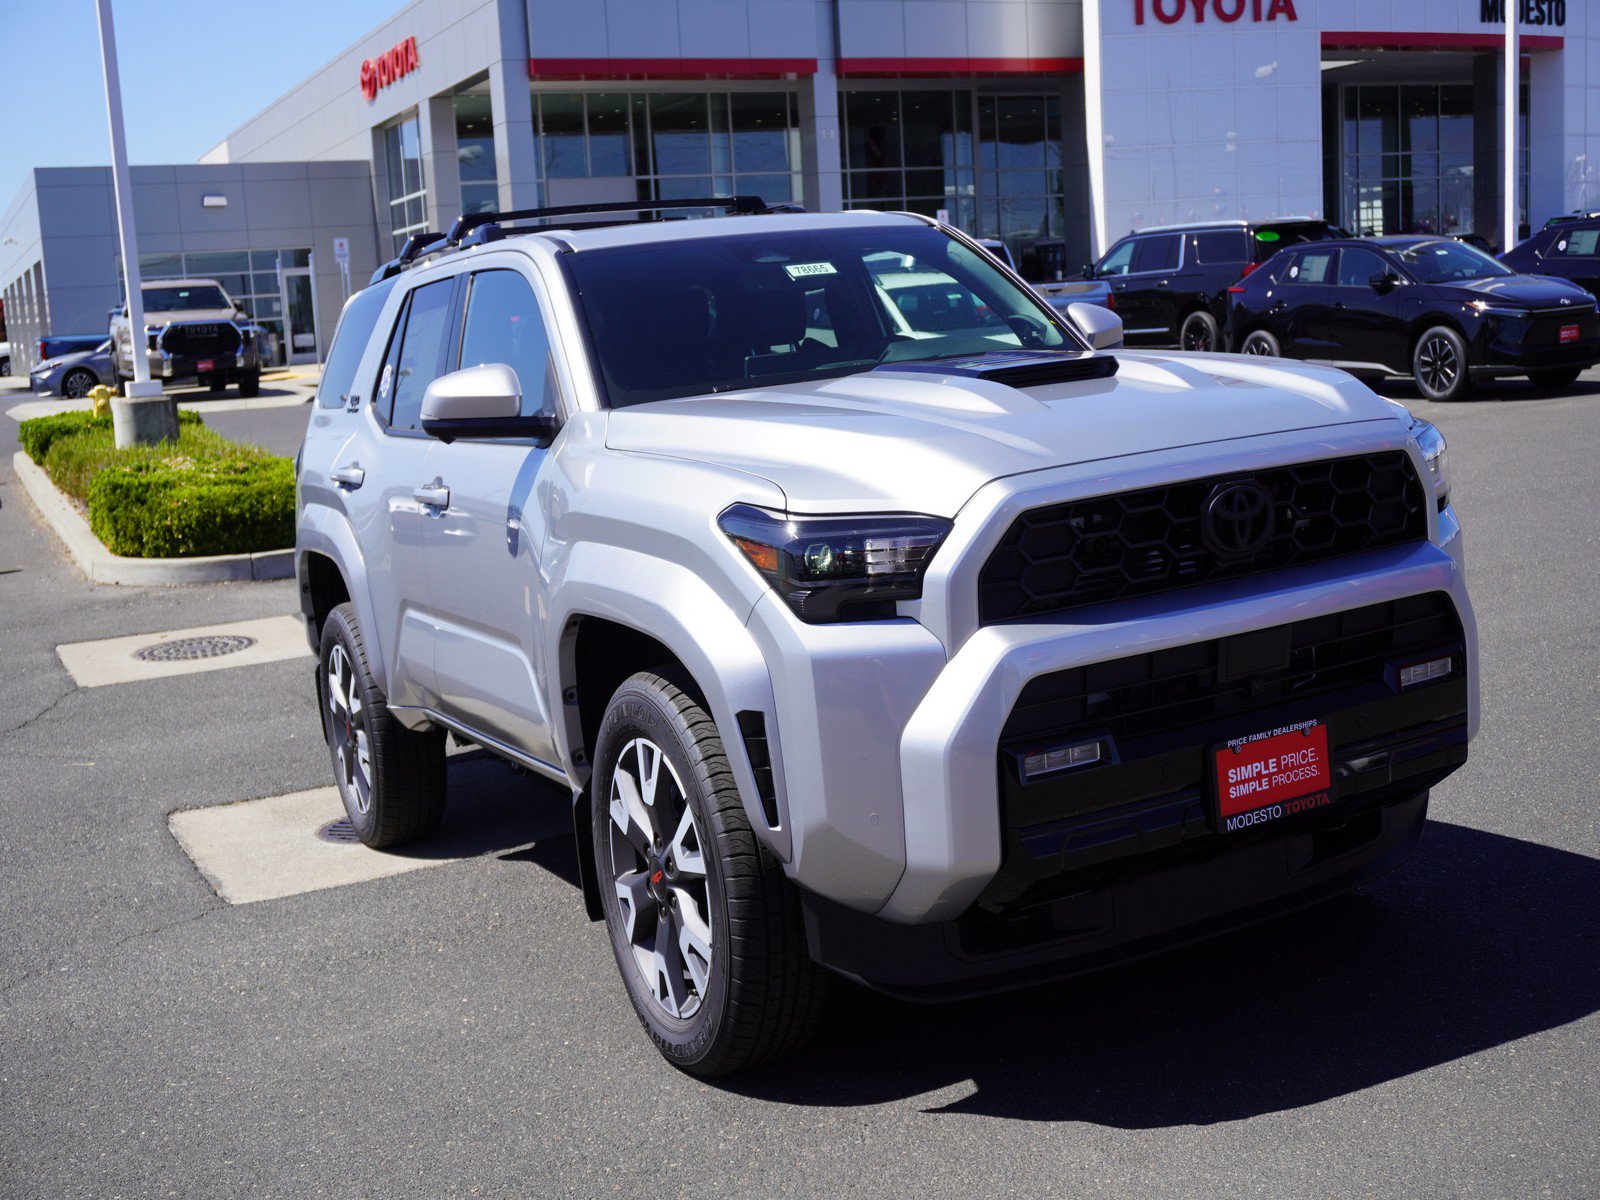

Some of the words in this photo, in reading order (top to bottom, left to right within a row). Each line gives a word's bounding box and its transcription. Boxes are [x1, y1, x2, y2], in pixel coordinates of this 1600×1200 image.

[375, 36, 419, 89] TOYOTA
[1227, 736, 1248, 748] PRICE
[1248, 729, 1272, 743] FAMILY
[1273, 719, 1318, 736] DEALERSHIPS
[1228, 757, 1278, 784] SIMPLE
[1281, 747, 1319, 770] PRICE.
[1229, 777, 1270, 799] SIMPLE
[1272, 764, 1321, 788] PROCESS.
[1226, 805, 1282, 832] MODESTO
[1285, 797, 1330, 816] TOYOTA
